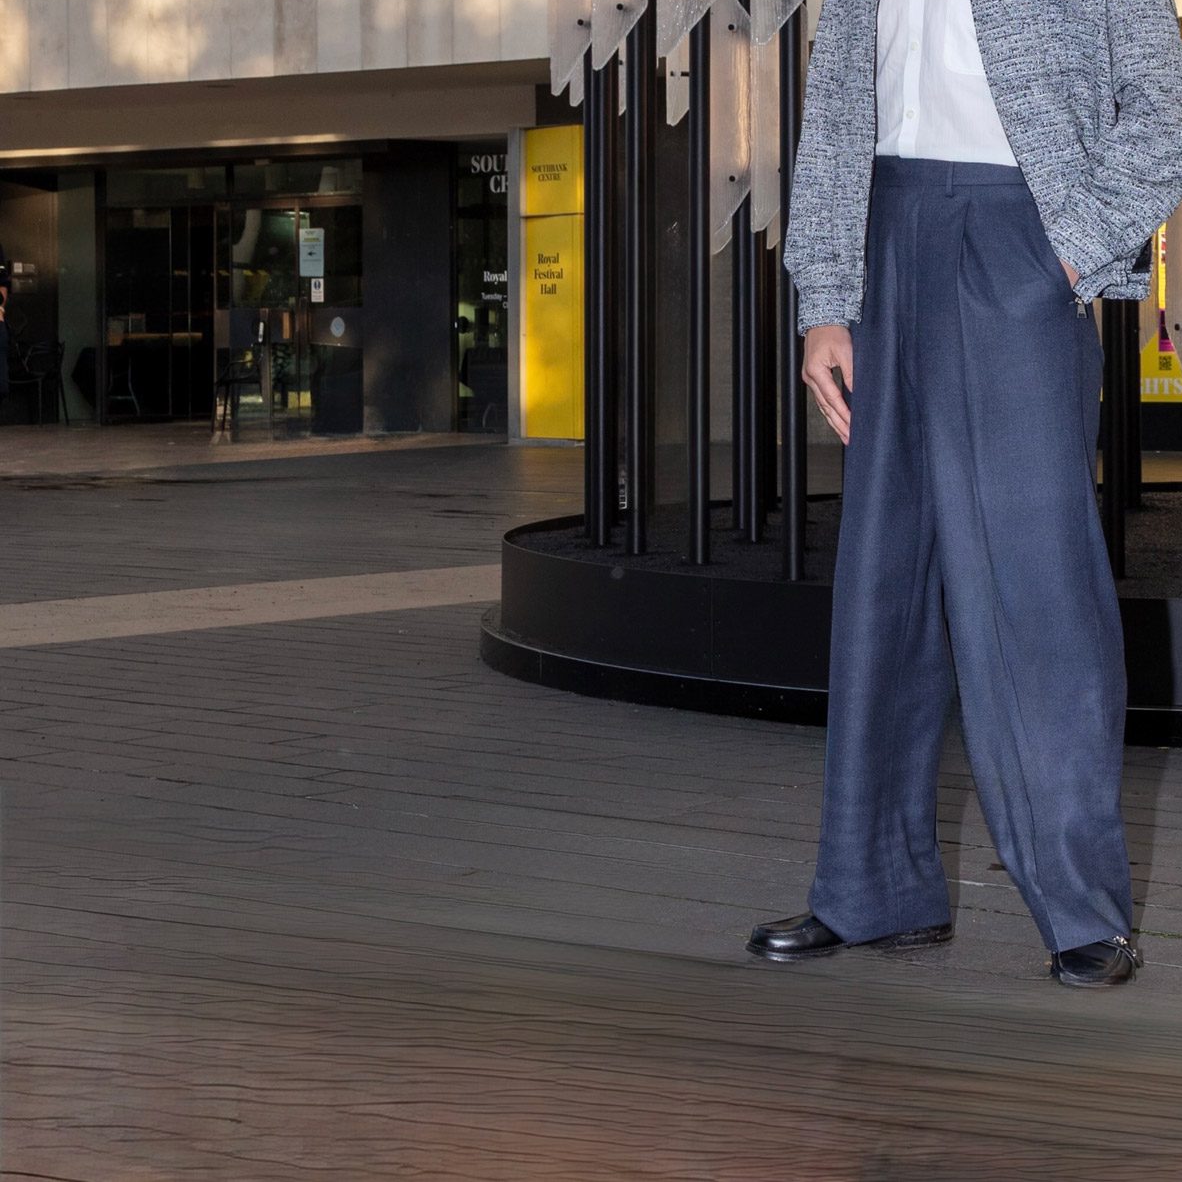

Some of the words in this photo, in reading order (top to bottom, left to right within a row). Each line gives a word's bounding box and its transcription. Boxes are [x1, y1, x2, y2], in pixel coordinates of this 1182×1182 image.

[471, 154, 508, 174] SOU
[531, 163, 568, 173] SOUTHBANK
[538, 173, 561, 182] CENTRE
[538, 252, 560, 267] Royal
[483, 270, 508, 285] Royal
[534, 268, 564, 280] Festival
[540, 283, 557, 295] Hall
